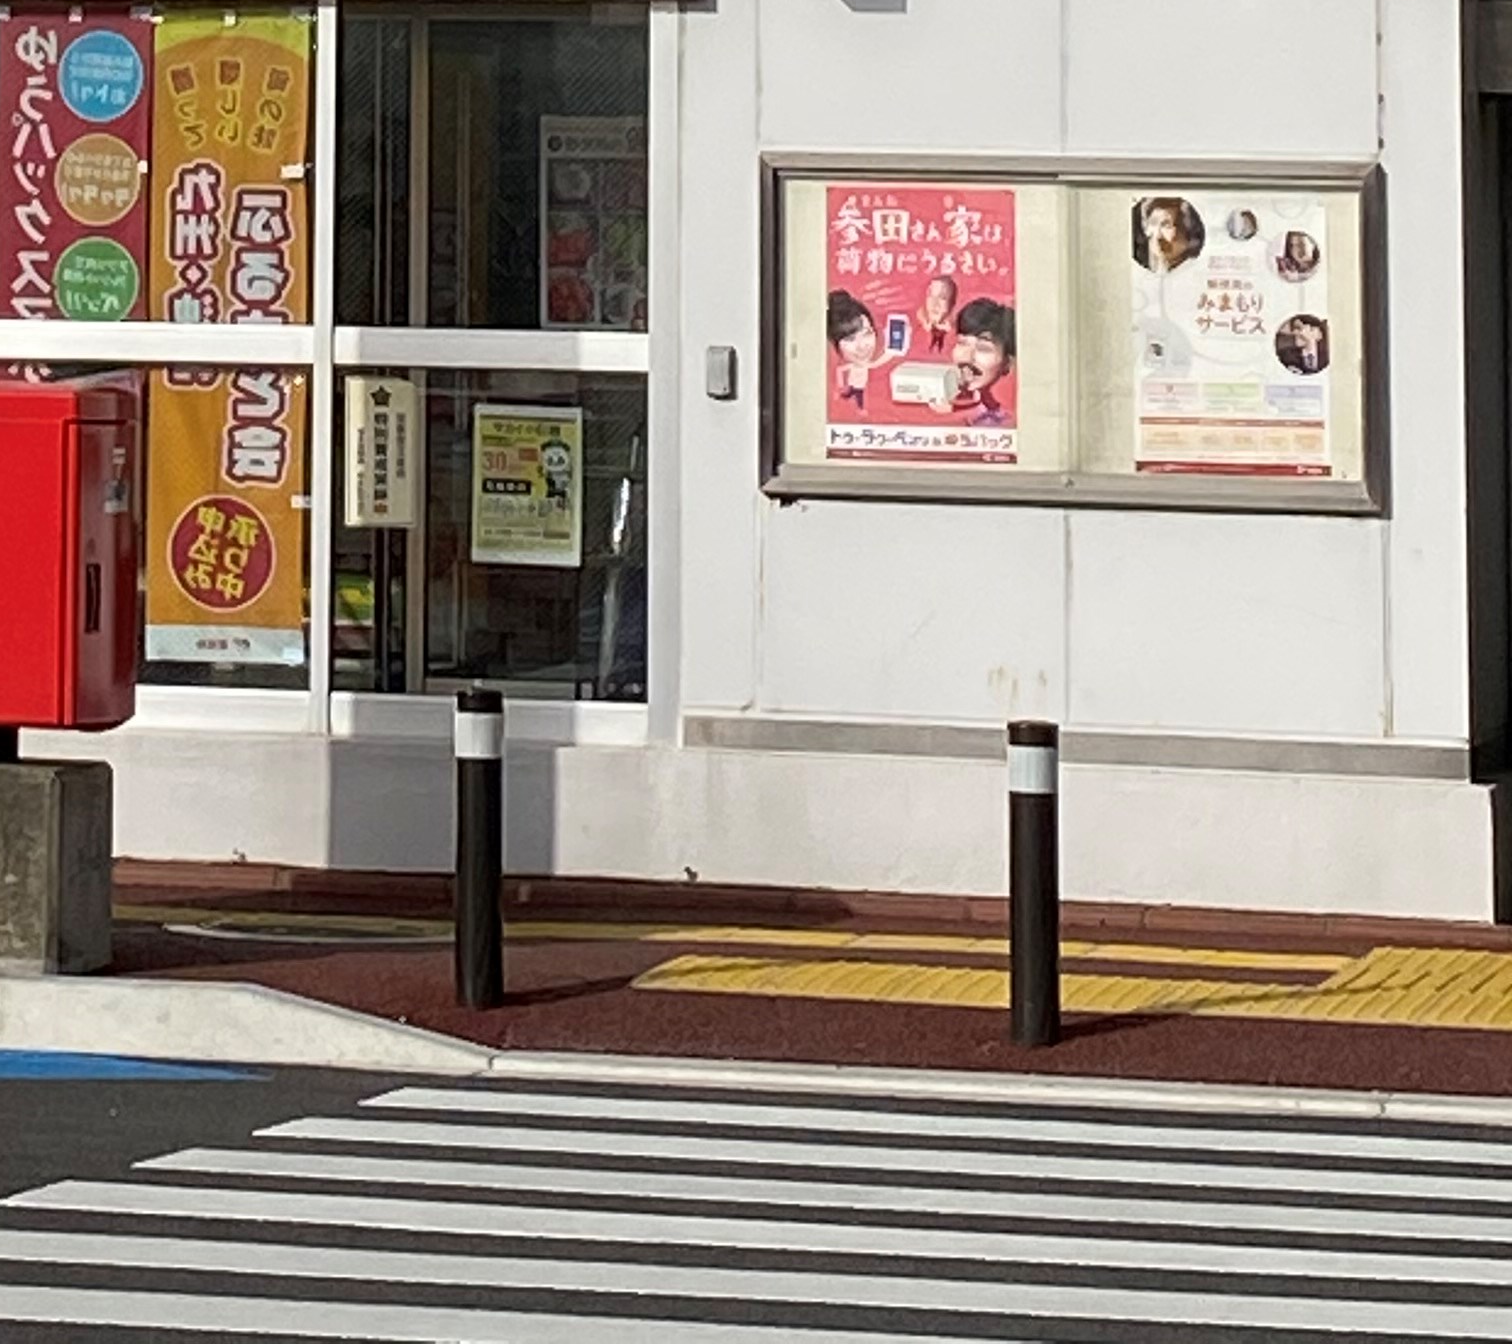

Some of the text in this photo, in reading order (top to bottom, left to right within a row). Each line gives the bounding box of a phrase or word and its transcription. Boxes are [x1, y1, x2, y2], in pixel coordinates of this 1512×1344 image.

[1196, 293, 1264, 313] みまもり
[1195, 315, 1267, 335] サービス
